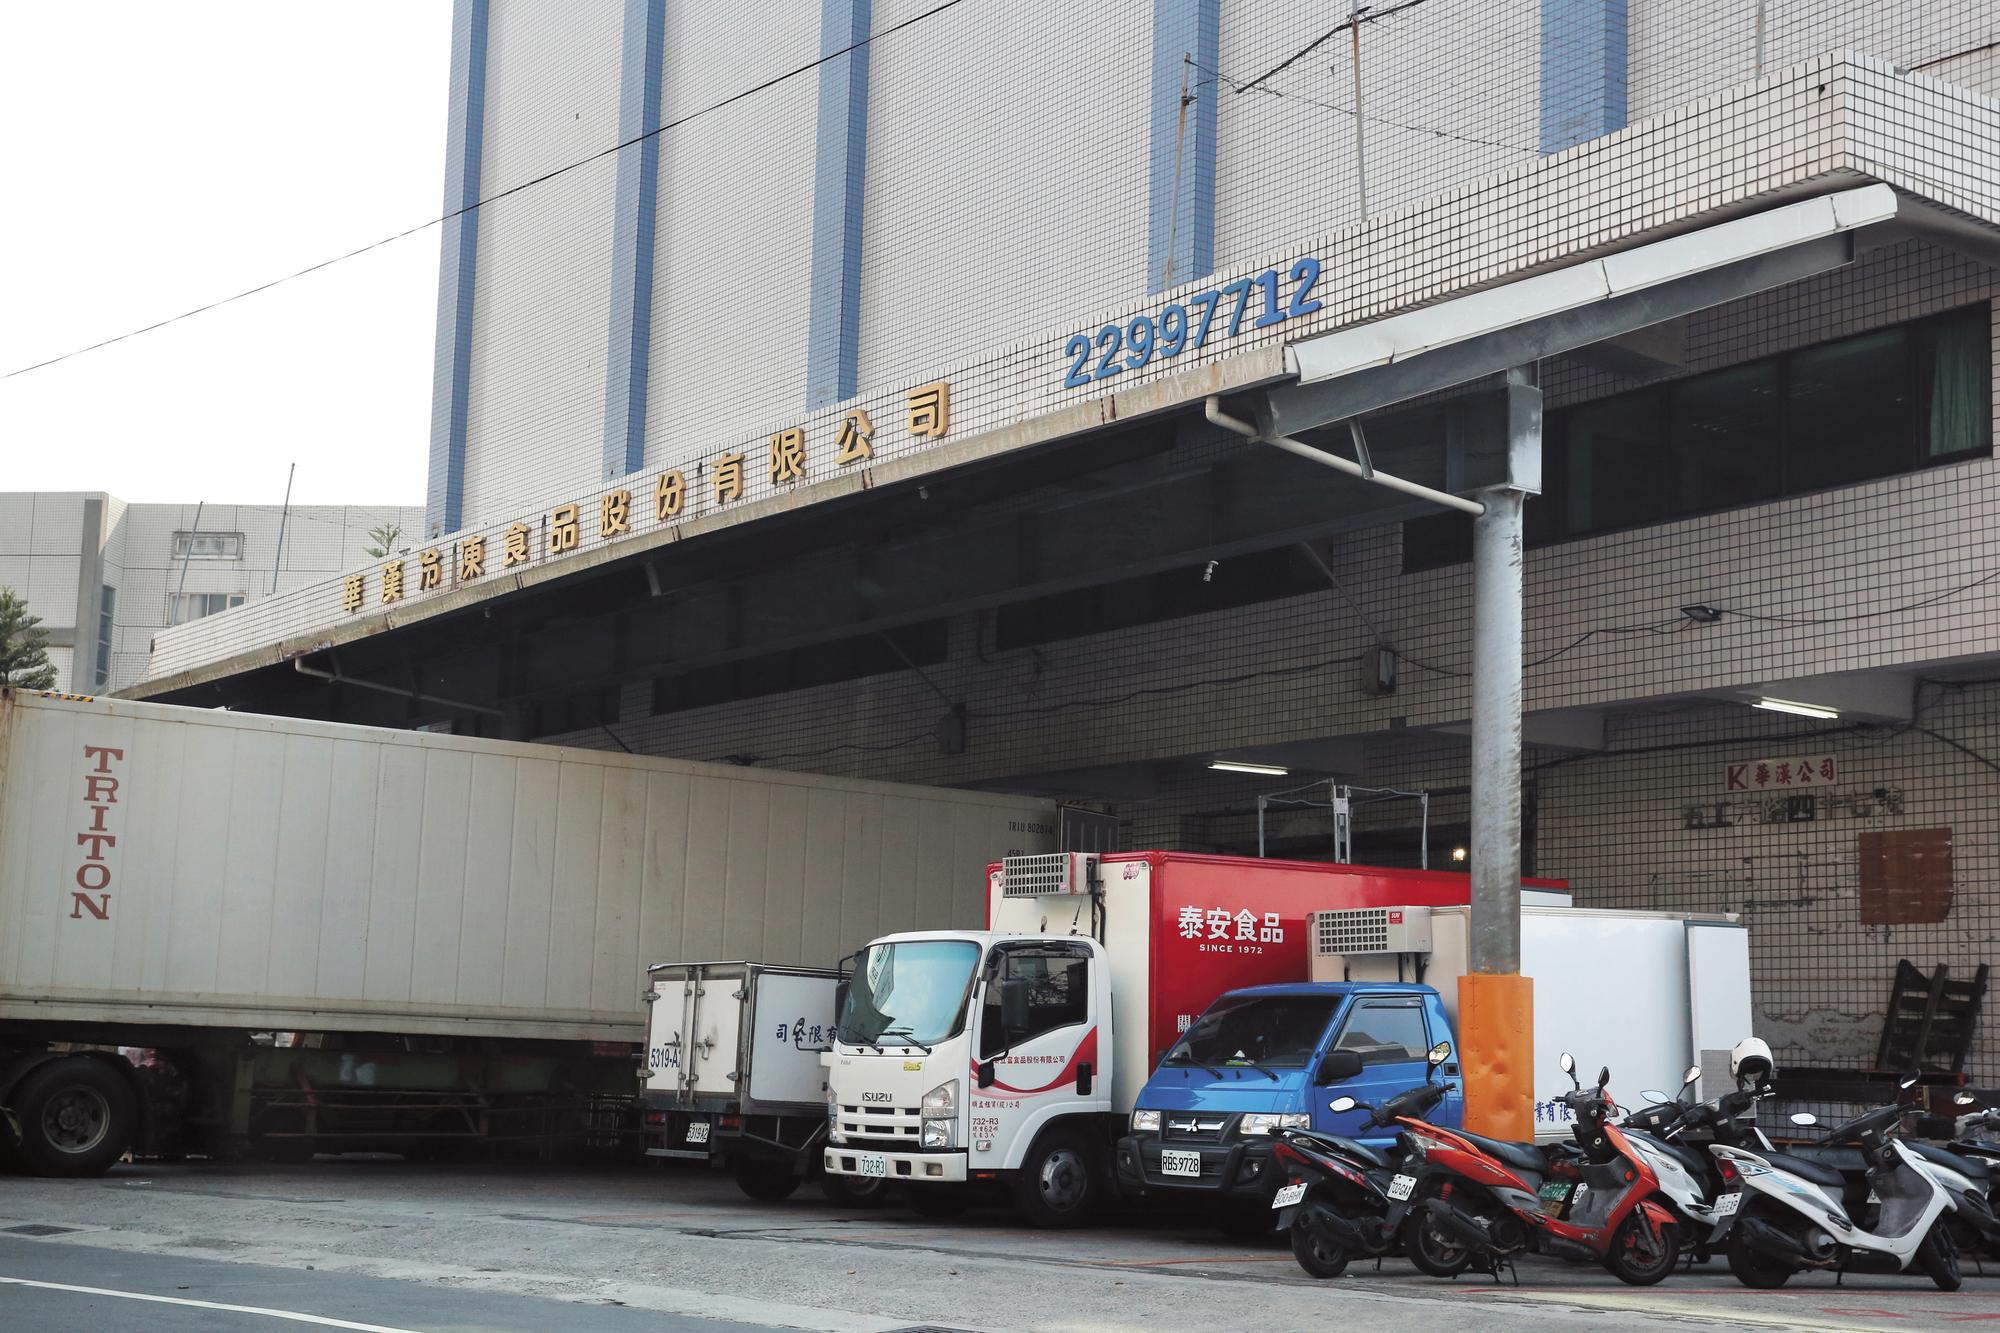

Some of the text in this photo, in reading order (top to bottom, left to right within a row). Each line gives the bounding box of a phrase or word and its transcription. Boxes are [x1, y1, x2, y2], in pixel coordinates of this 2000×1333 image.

[1064, 258, 1322, 388] 22997712
[342, 381, 949, 612] 華漢冷凍食品股份有限公司
[1727, 758, 1835, 790] K 華漢公司
[70, 744, 124, 920] TRITON
[1008, 820, 1025, 832] TRIU
[1178, 905, 1284, 944] 泰安食品
[1199, 944, 1263, 954] SINCE 1972
[650, 1047, 682, 1069] 5319-A
[862, 1092, 893, 1102] ISUZU
[1534, 1102, 1577, 1122] 業有限
[861, 1158, 886, 1175] 732-R3
[1162, 1156, 1199, 1173] RBS-9728
